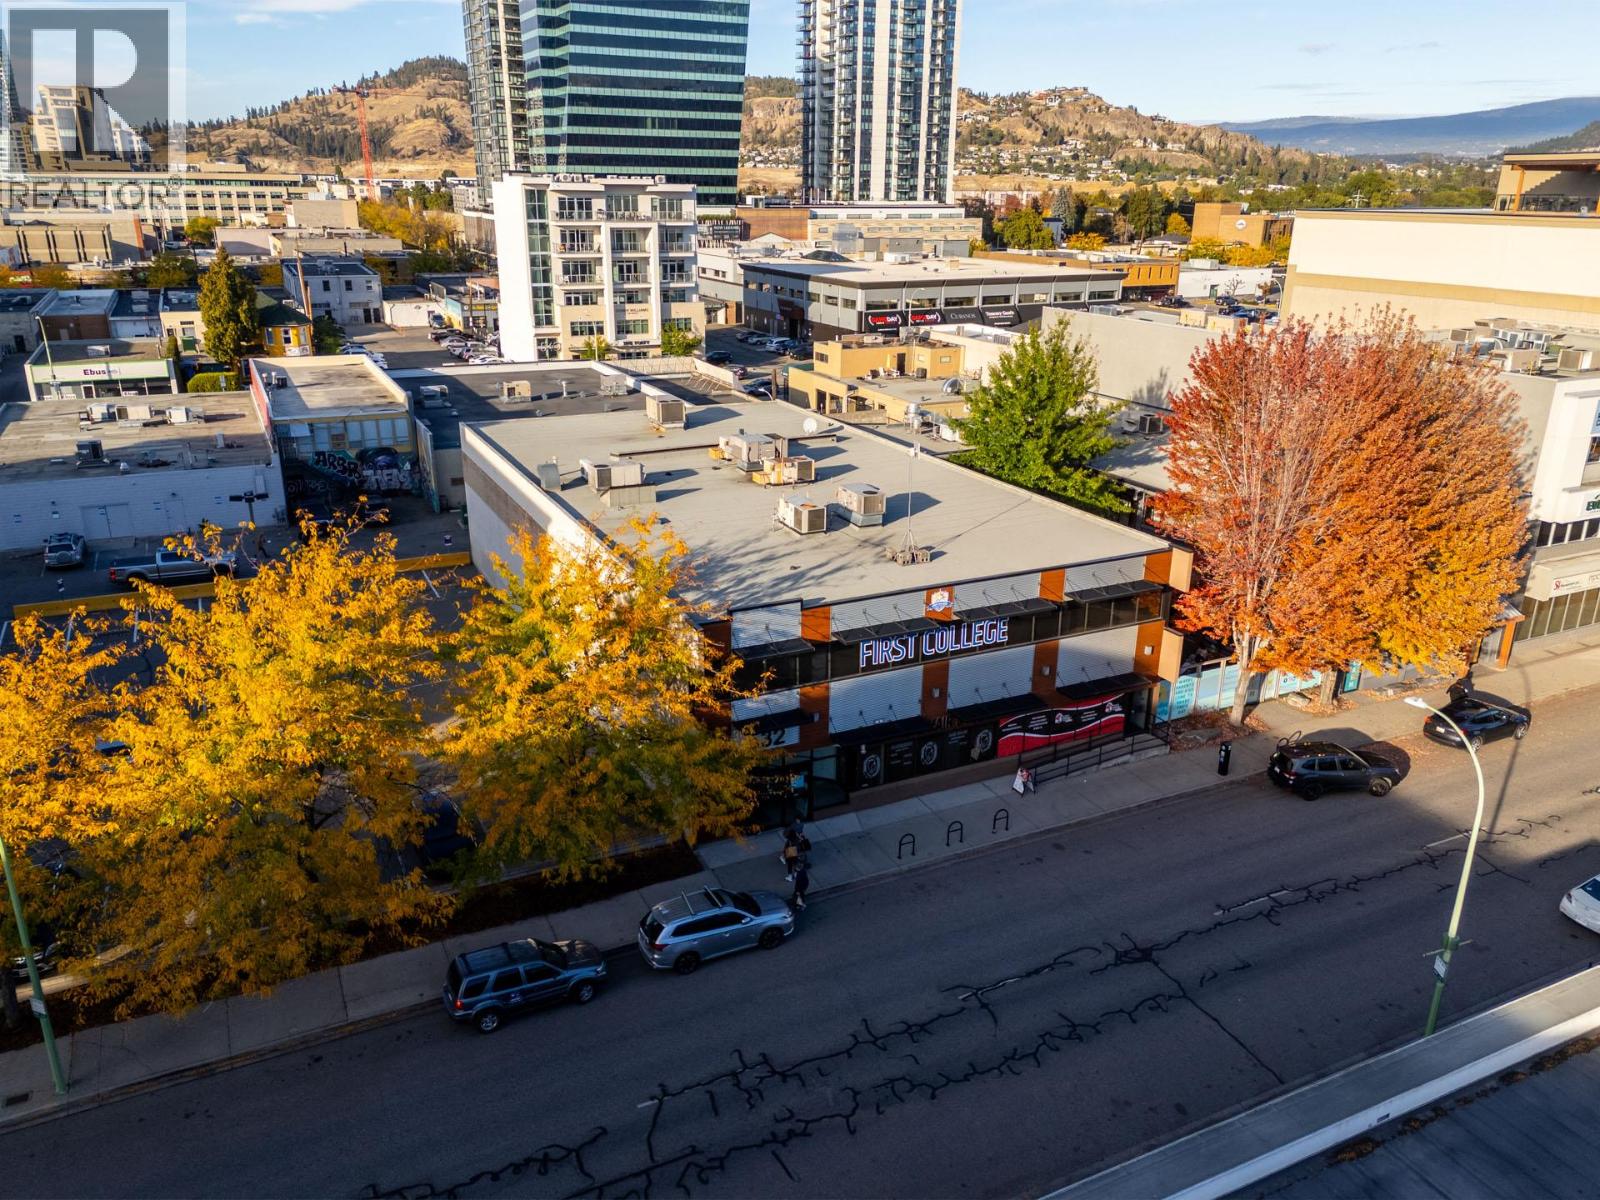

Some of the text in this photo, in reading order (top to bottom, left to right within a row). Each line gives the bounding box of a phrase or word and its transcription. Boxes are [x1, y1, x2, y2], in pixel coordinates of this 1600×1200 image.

[83, 368, 106, 376] Ebus
[859, 617, 1009, 668] FIRST COLLEGE
